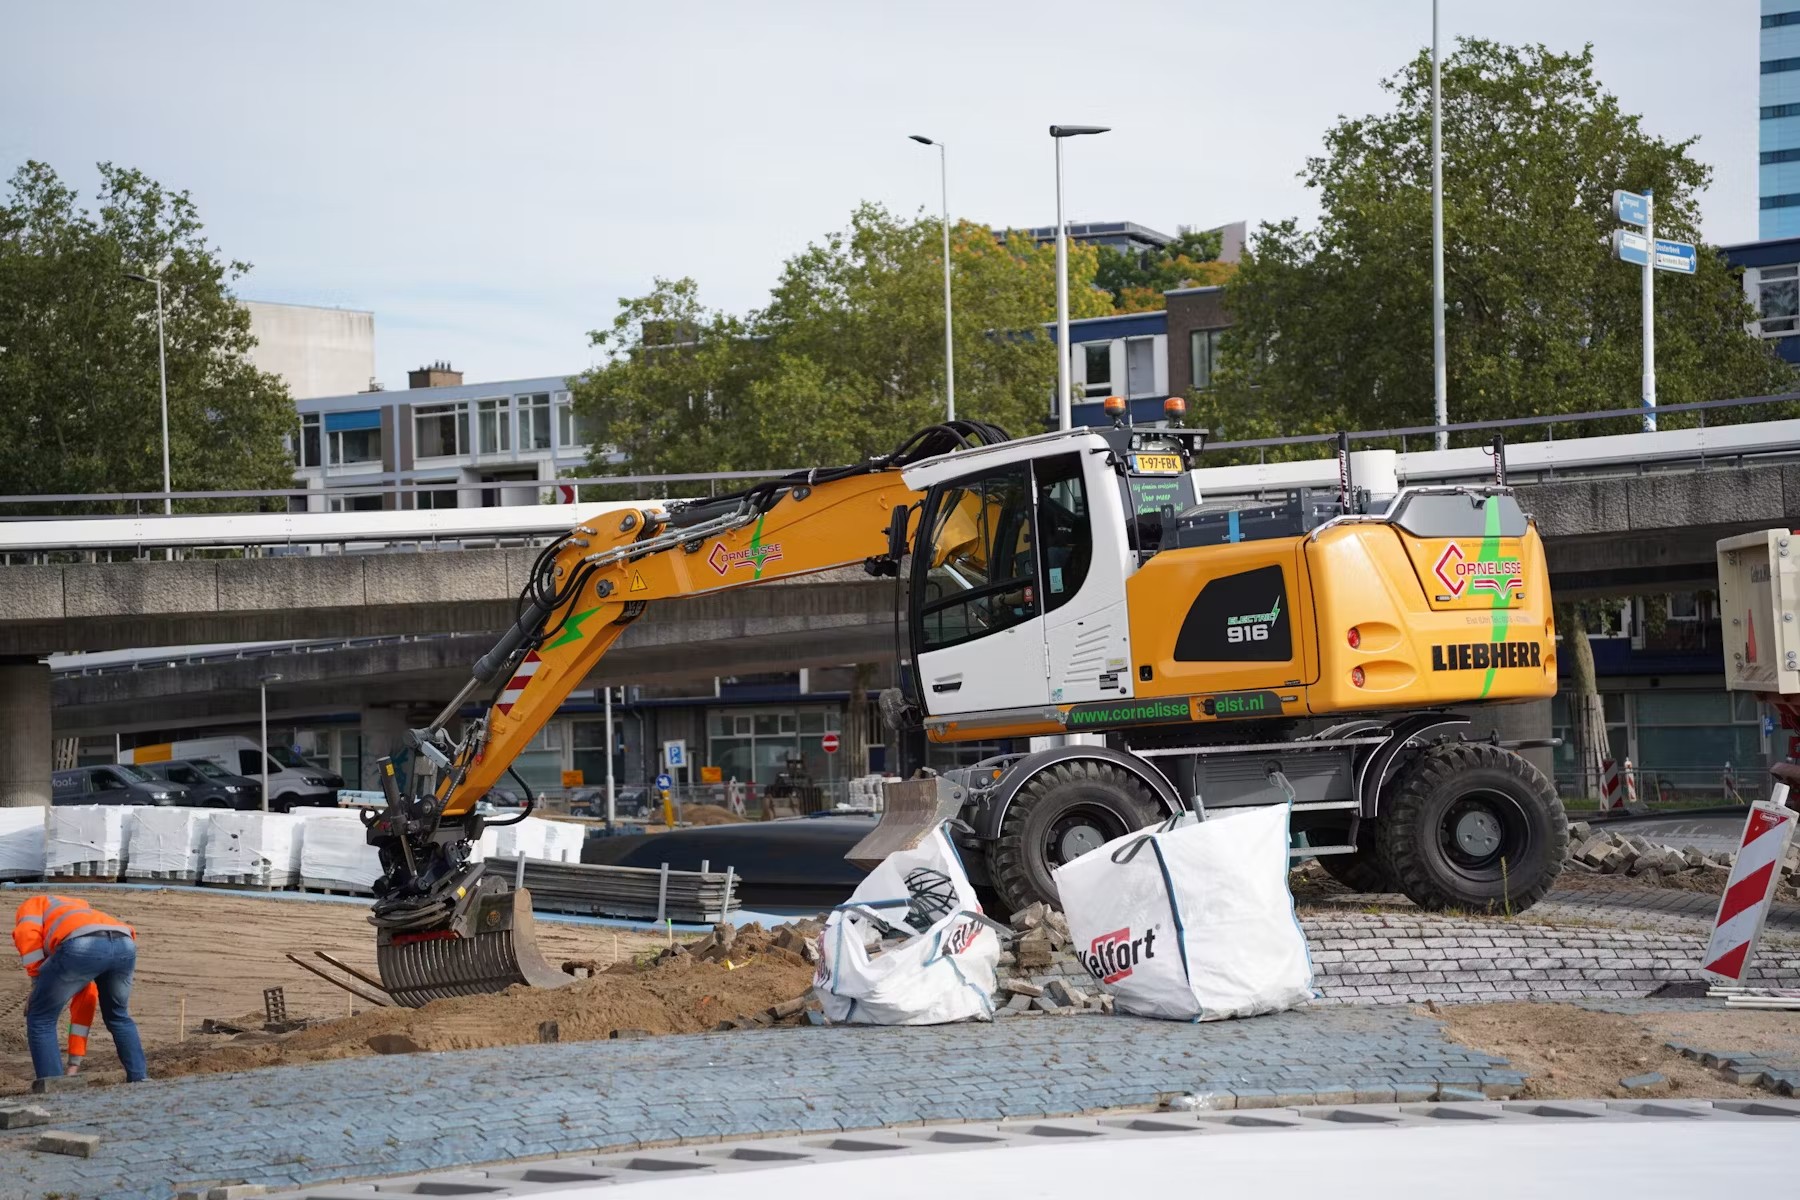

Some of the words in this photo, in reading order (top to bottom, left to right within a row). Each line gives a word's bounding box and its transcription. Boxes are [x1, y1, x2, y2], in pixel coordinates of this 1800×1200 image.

[1139, 457, 1178, 470] T-97-FBK
[709, 543, 781, 575] CORNELISSE
[1435, 543, 1522, 596] CORNELISSE
[1227, 612, 1276, 626] ELECTRIC
[1227, 623, 1269, 643] 916
[1432, 642, 1541, 671] LIEBHERR
[1076, 928, 1156, 980] Kelfort
